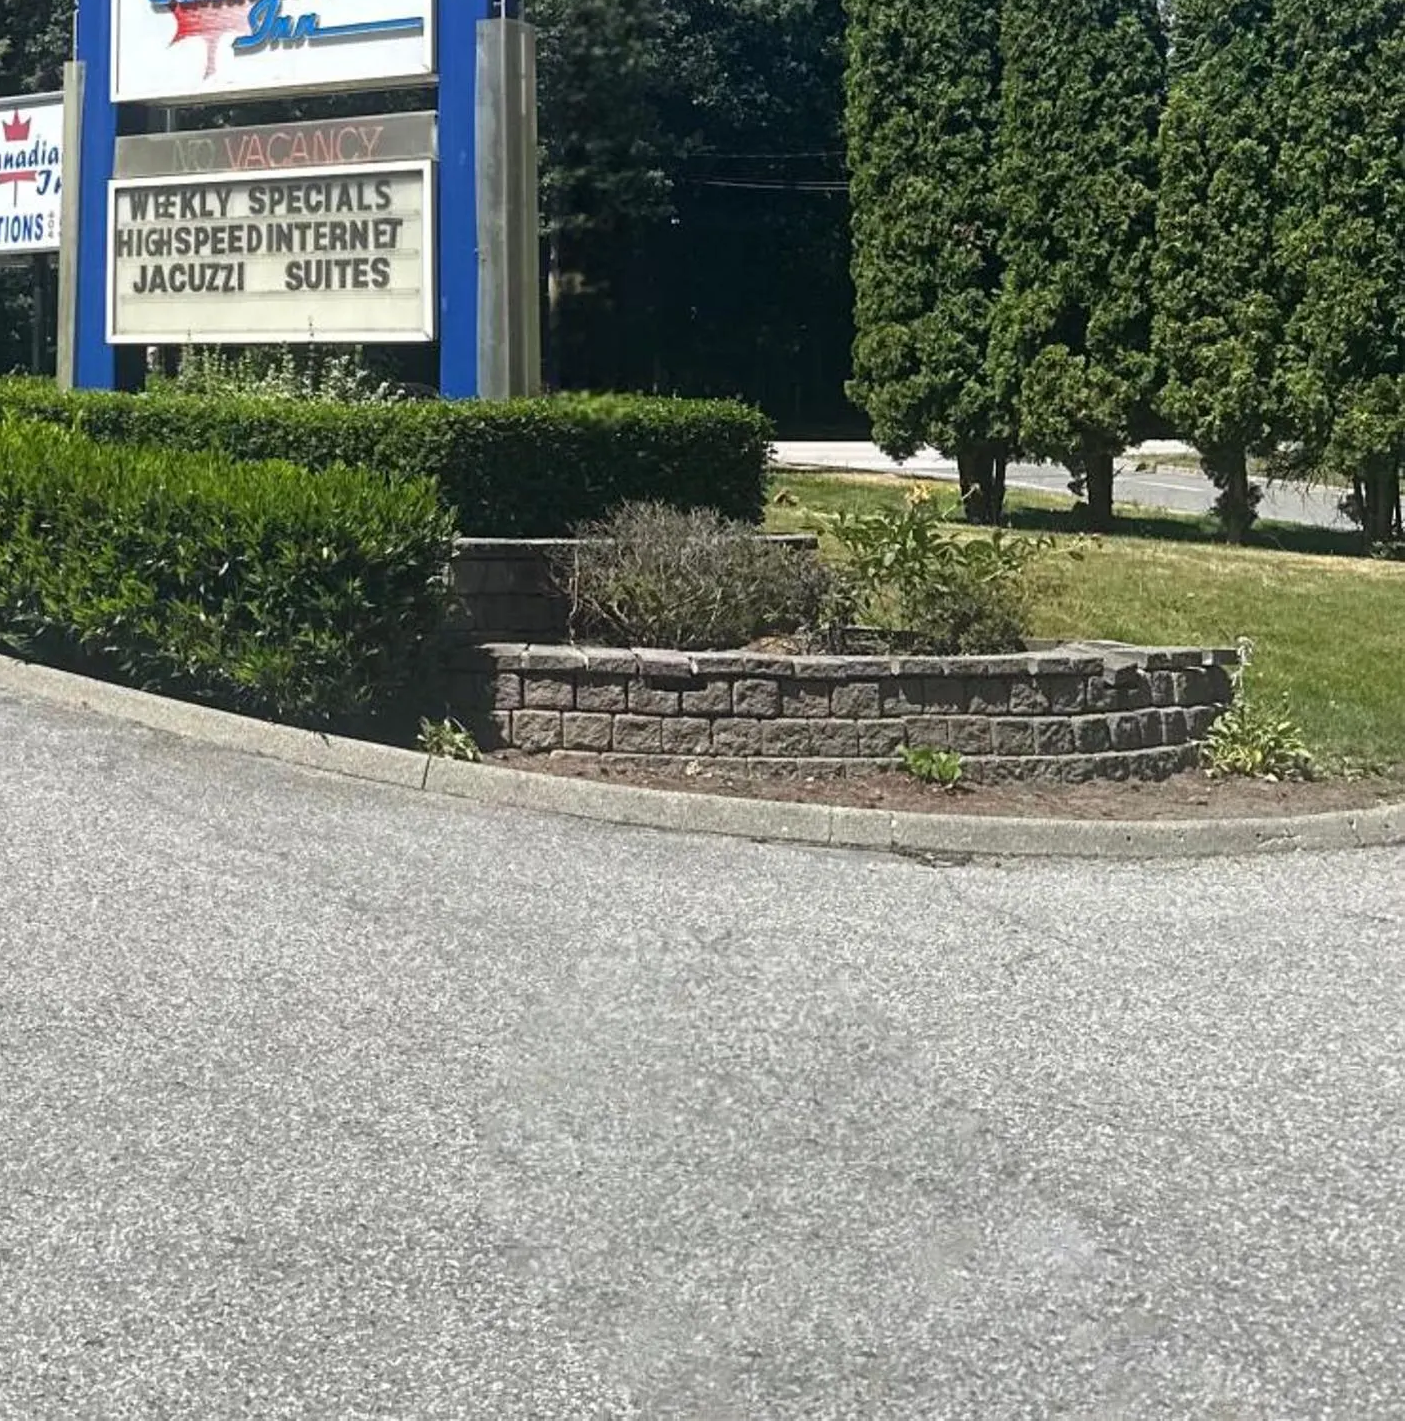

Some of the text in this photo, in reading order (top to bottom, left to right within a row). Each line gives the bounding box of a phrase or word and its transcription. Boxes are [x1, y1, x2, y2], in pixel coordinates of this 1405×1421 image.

[171, 126, 384, 173] NO VACANCY
[128, 179, 392, 221] WEEKLY SPECIALS
[132, 256, 391, 294] JACUZZI SUITES
